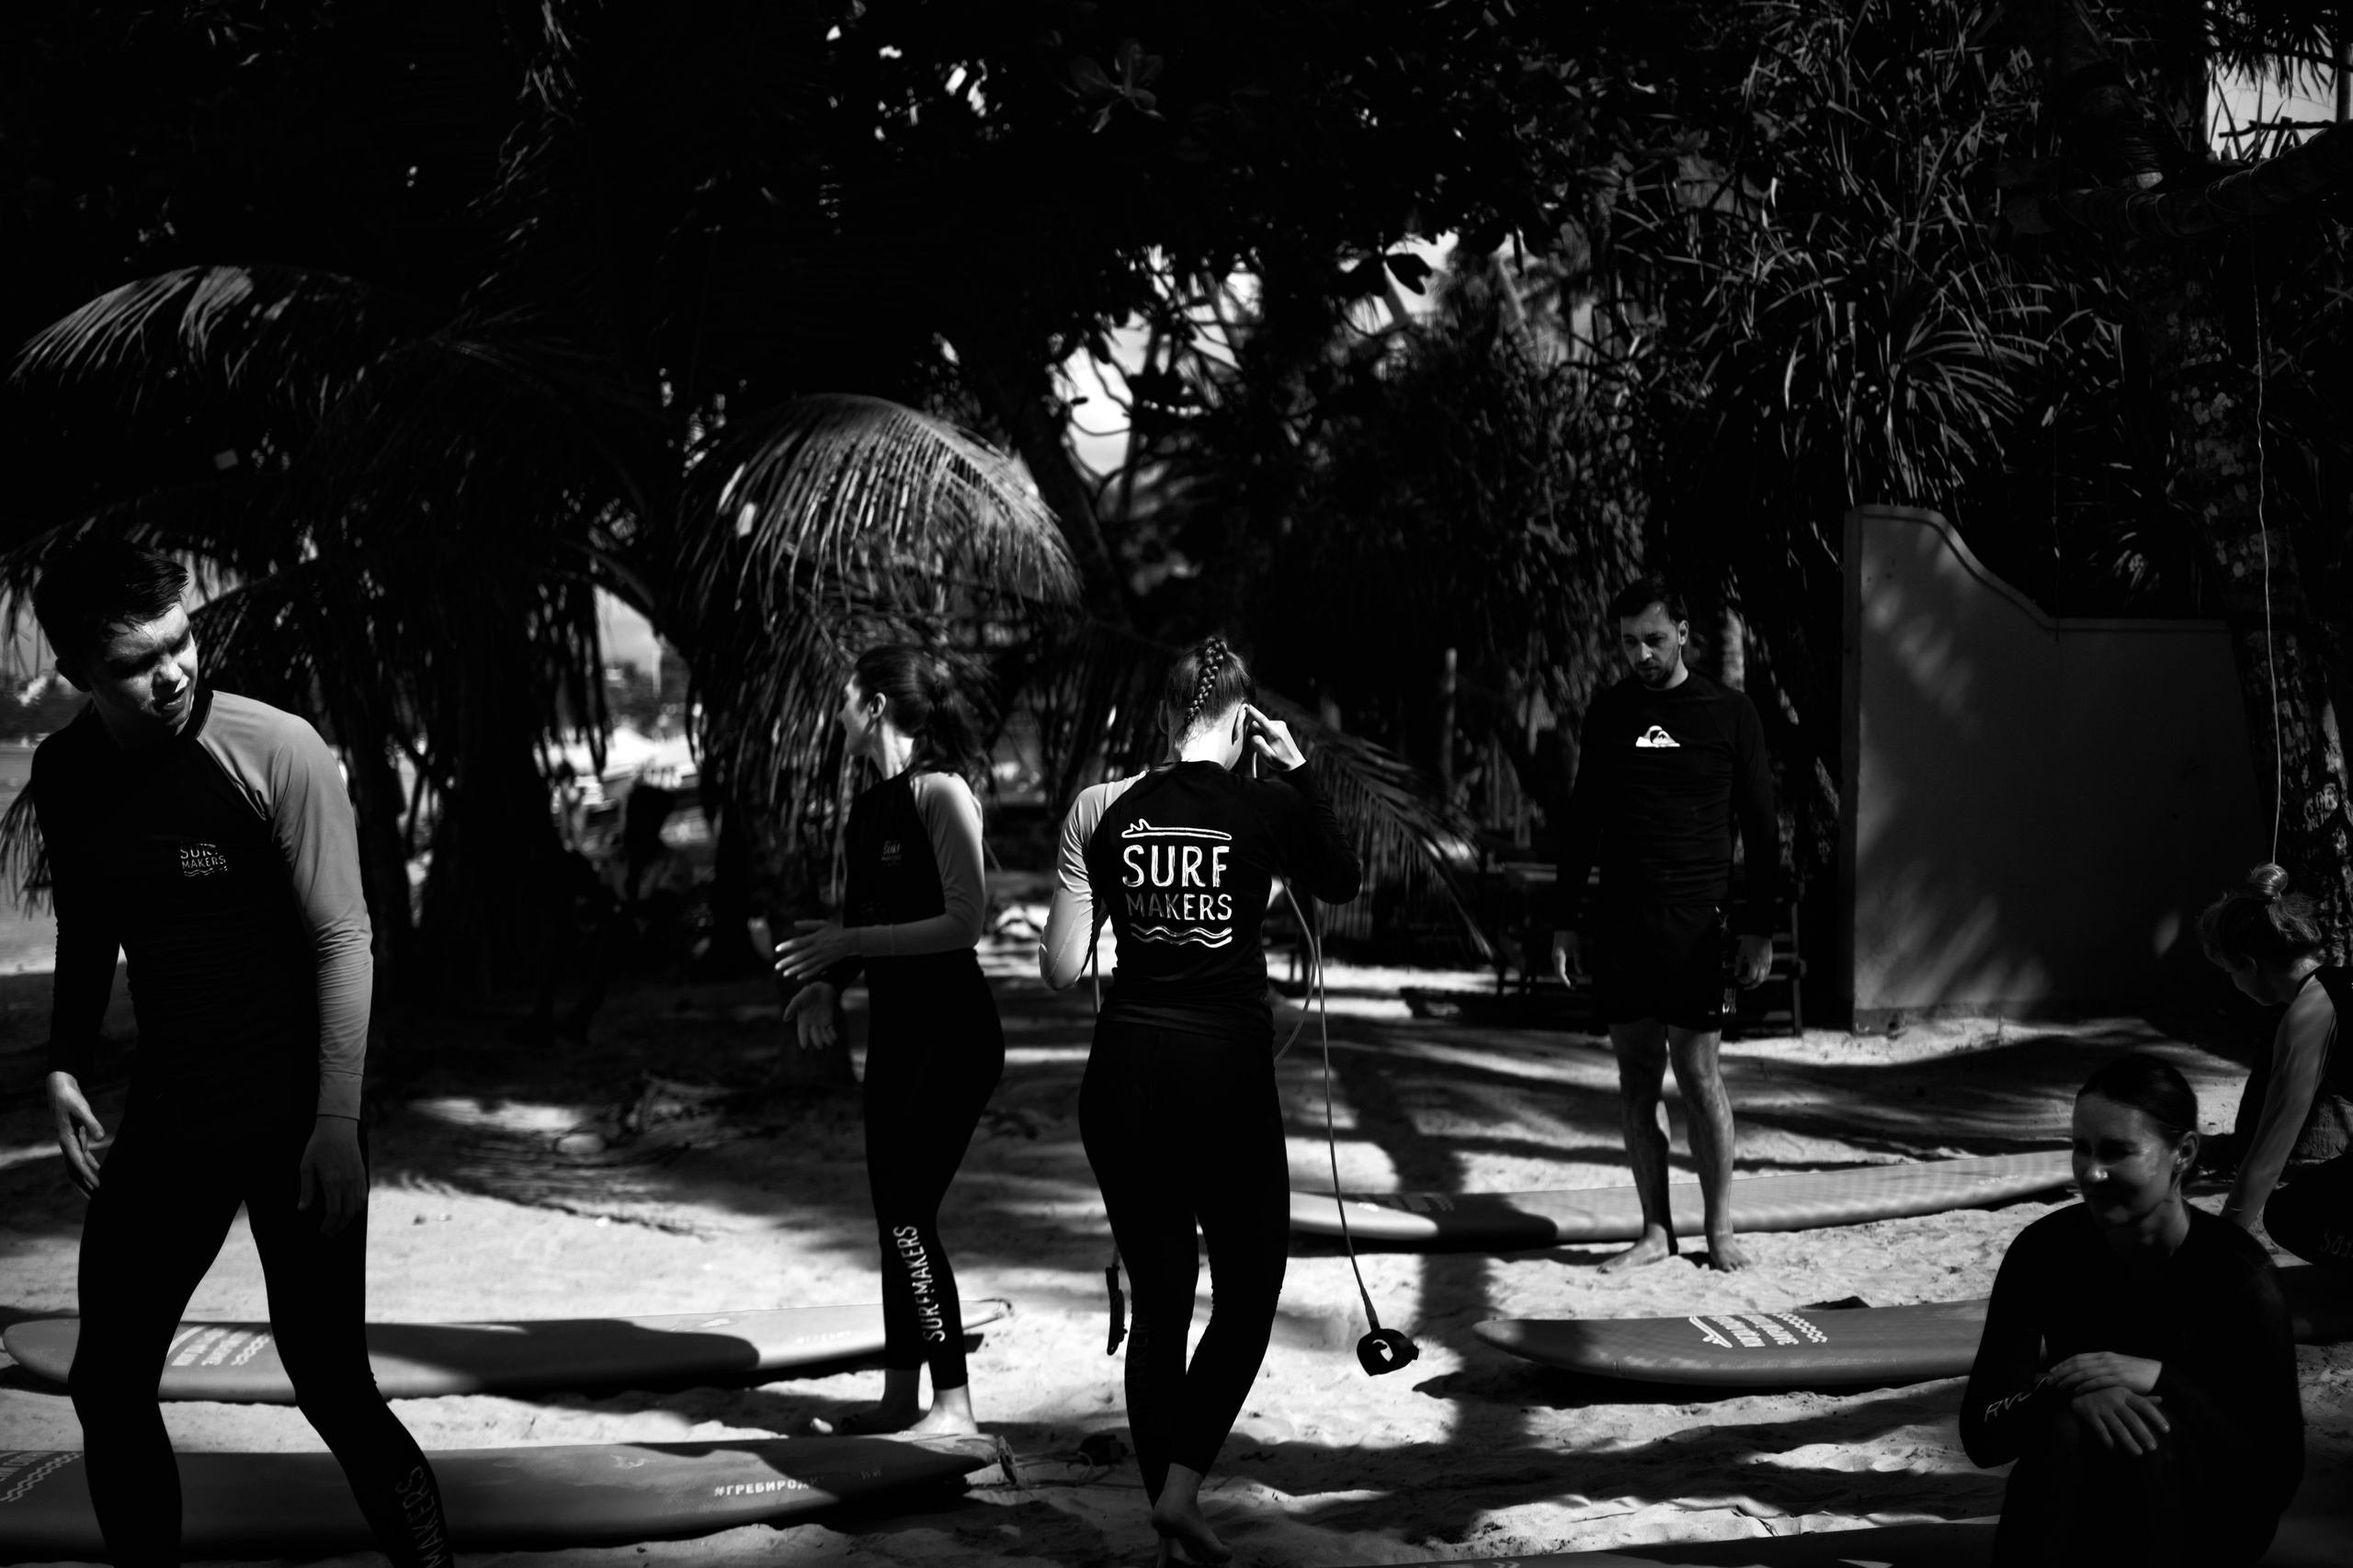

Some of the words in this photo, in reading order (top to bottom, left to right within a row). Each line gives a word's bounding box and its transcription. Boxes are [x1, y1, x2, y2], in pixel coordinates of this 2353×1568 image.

[181, 855, 226, 869] MAKERS
[1121, 844, 1231, 888] SURF
[1124, 892, 1233, 921] MAKERS
[892, 1225, 946, 1343] SURFMAKERS
